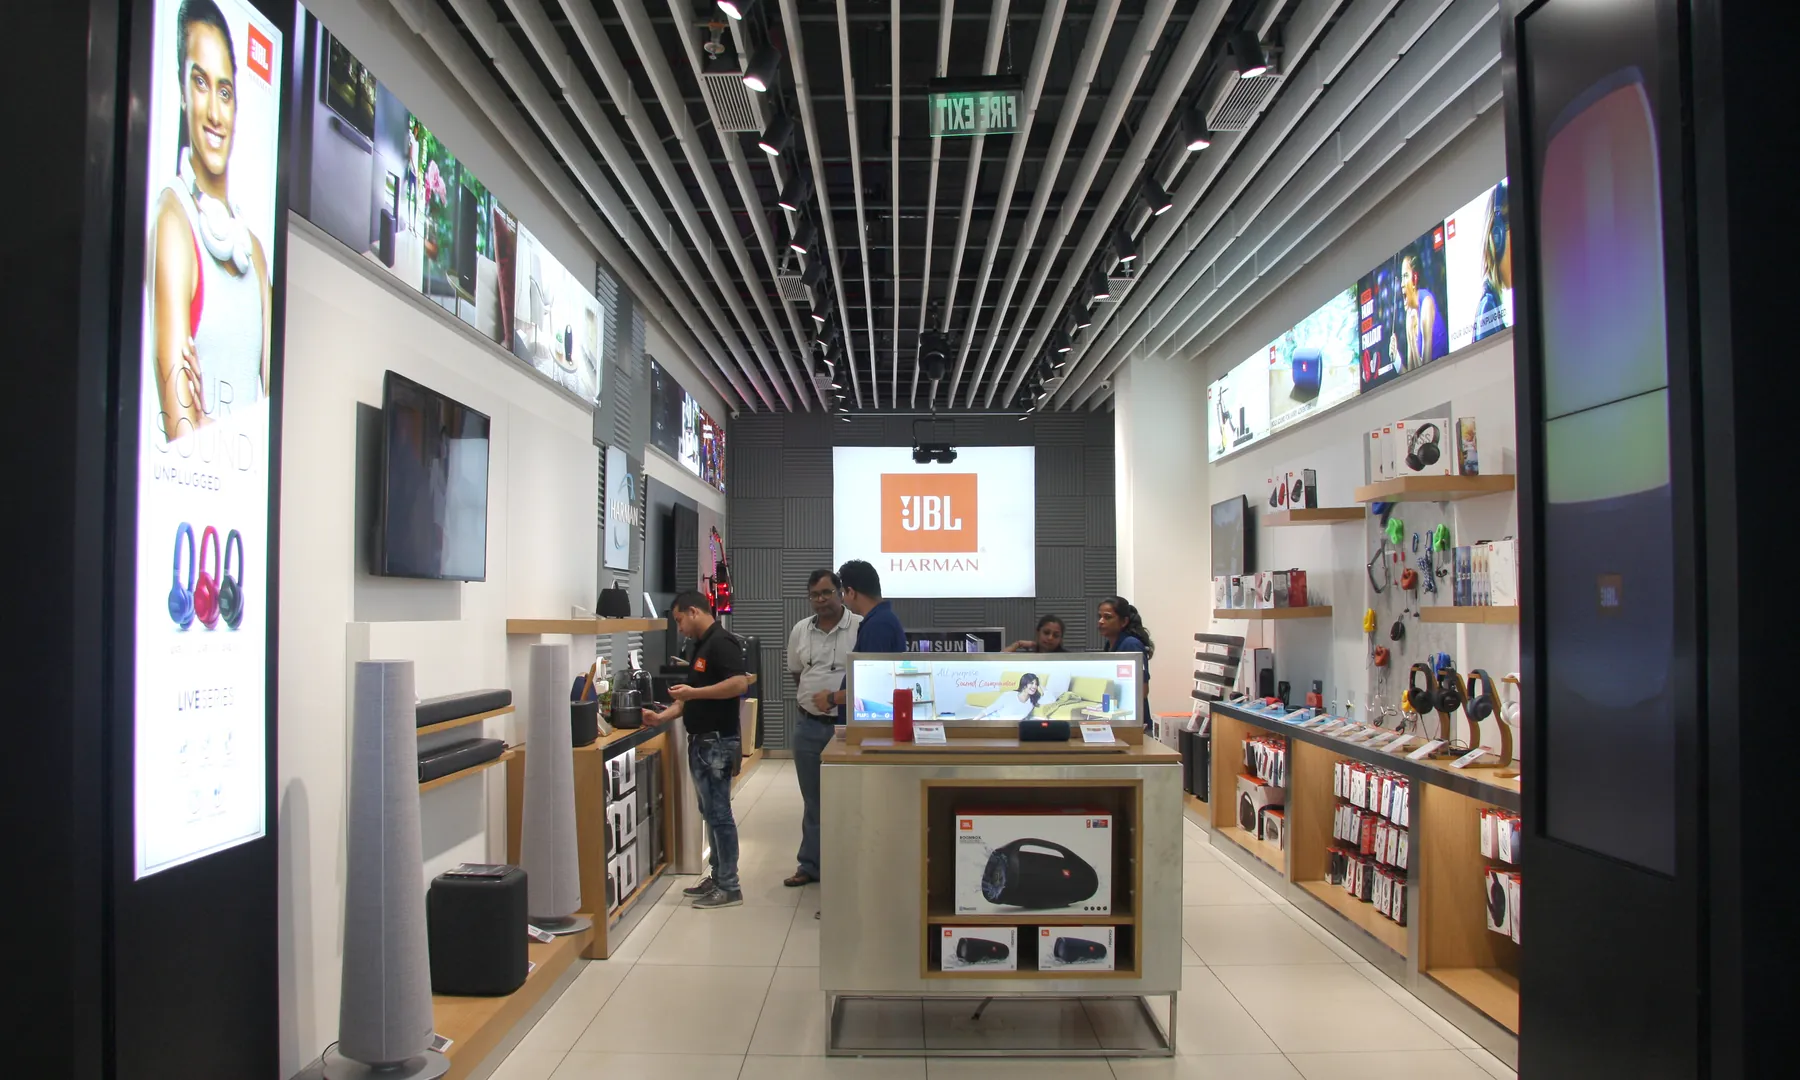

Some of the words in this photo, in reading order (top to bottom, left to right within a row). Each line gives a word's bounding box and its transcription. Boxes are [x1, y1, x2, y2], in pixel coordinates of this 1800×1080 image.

[252, 38, 268, 70] JBL
[158, 364, 234, 417] YOUR
[153, 465, 221, 491] UNPLUGGED
[609, 498, 639, 527] HARMAN
[900, 495, 962, 531] JBL
[890, 558, 979, 572] HARMAN
[906, 639, 964, 652] SASUN
[178, 690, 199, 711] LIVE
